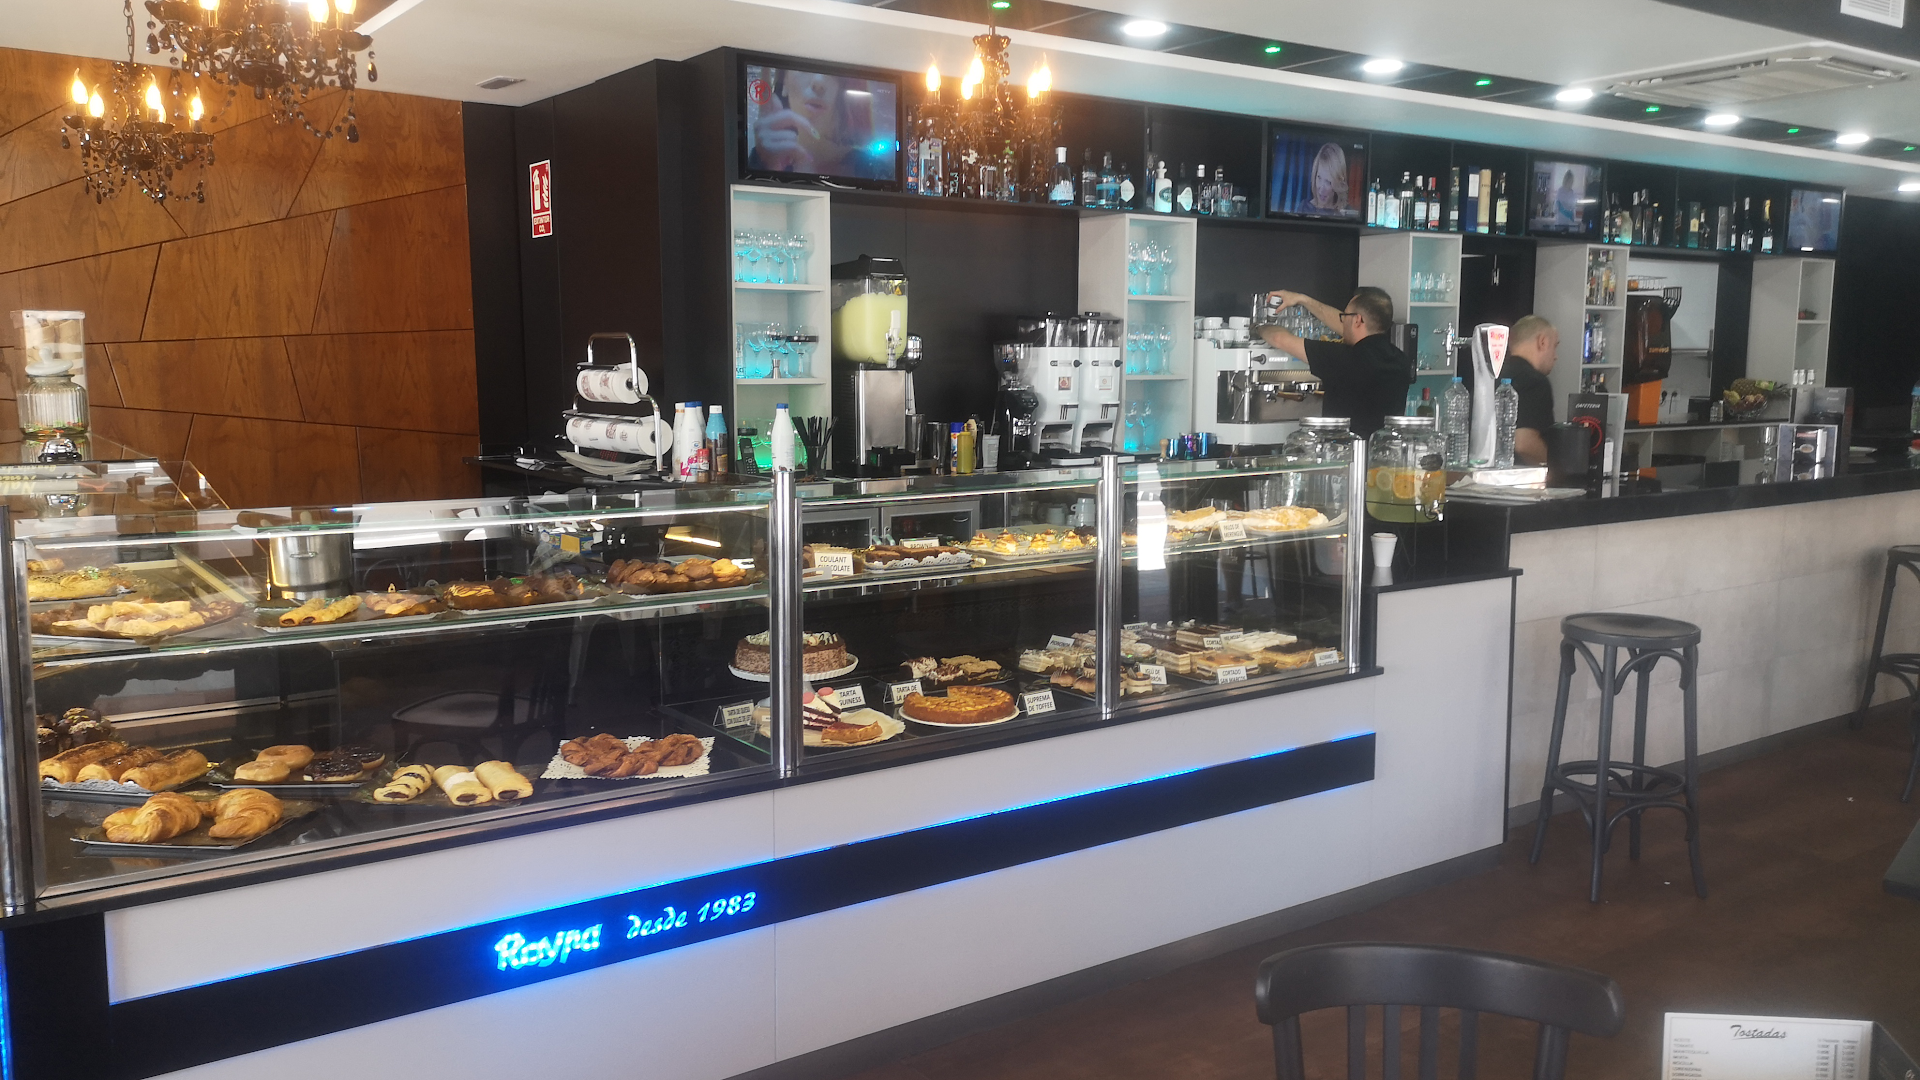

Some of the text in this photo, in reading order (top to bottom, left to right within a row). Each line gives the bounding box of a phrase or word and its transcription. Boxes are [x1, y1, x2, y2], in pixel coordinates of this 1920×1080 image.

[820, 555, 847, 563] COULANT
[1222, 669, 1242, 677] CORTADO
[839, 689, 857, 698] TARTA
[1026, 694, 1051, 704] SUPREMA
[1036, 701, 1053, 710] TOFFEE
[626, 906, 689, 940] desde
[697, 891, 757, 924] 1983
[1730, 1024, 1788, 1039] Tostadas
